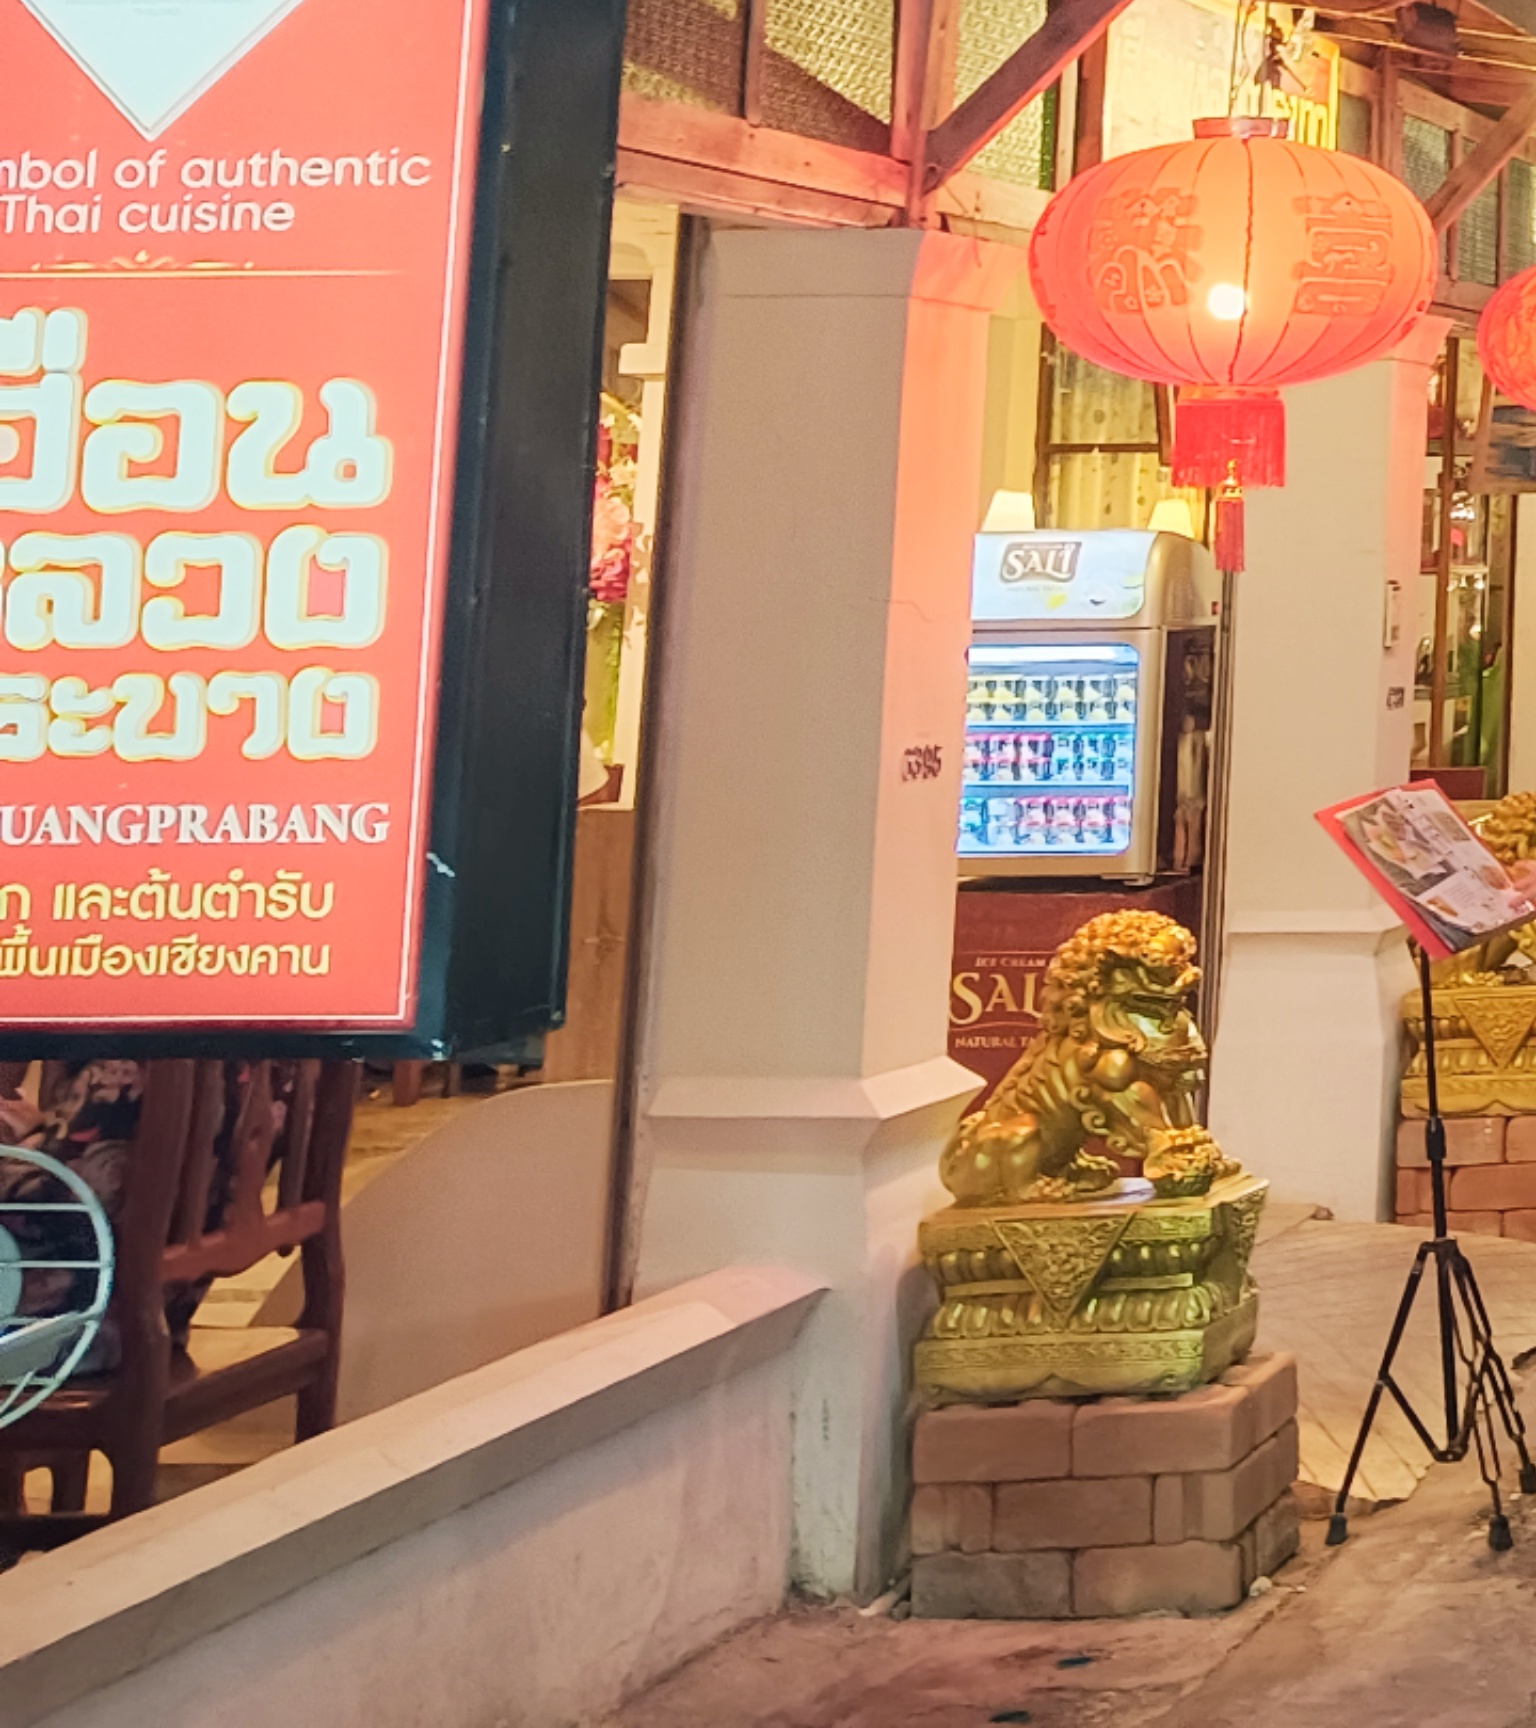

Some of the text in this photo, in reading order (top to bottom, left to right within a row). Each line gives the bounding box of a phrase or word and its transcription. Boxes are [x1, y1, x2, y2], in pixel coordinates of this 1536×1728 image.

[114, 148, 167, 189] of
[181, 147, 431, 188] authentic
[0, 193, 295, 234] Thai cuisine
[0, 804, 389, 845] UANGPRABANG
[53, 868, 334, 920] และต้นตำรับ
[955, 1036, 1018, 1048] NATURAL
